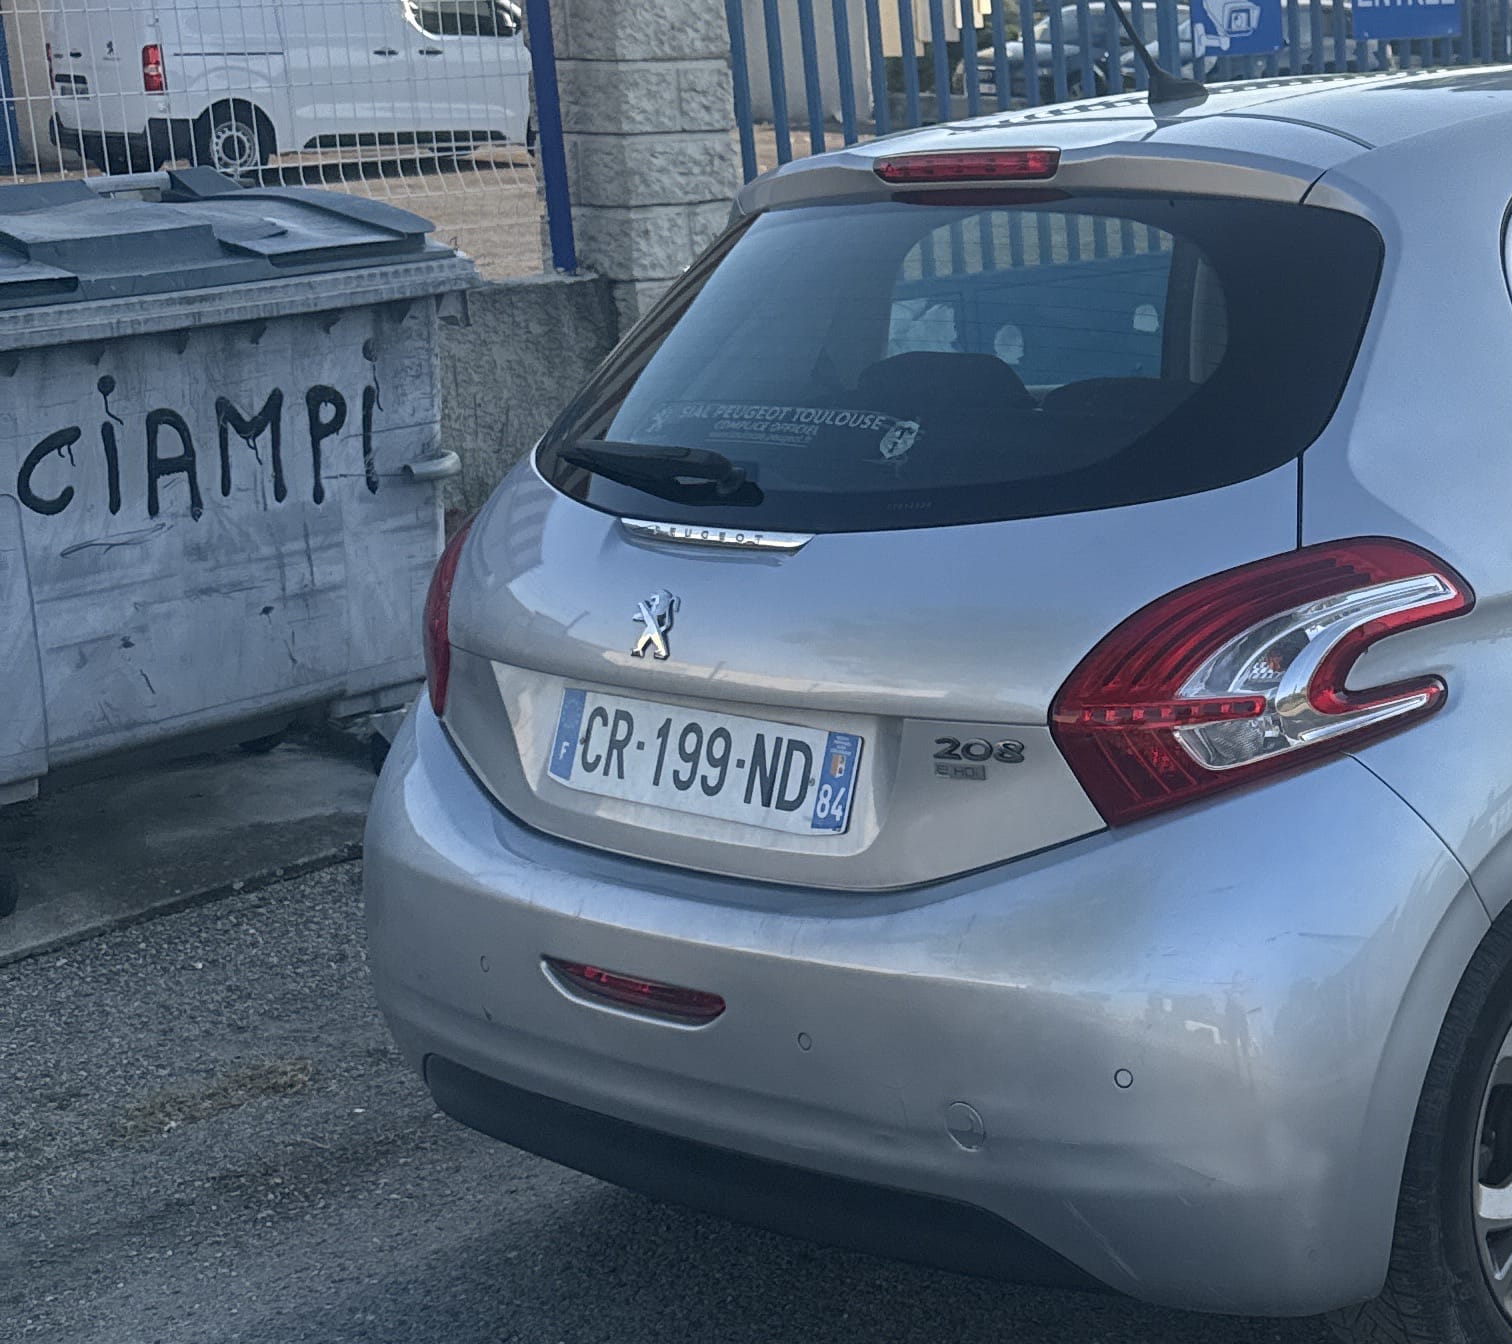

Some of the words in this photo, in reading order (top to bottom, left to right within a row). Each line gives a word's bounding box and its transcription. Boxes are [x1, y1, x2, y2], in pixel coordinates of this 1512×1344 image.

[713, 405, 790, 422] PEUGEOT
[790, 407, 886, 430] TOULOUSE
[559, 741, 570, 760] F
[933, 736, 1025, 764] 208
[816, 783, 846, 821] 84
